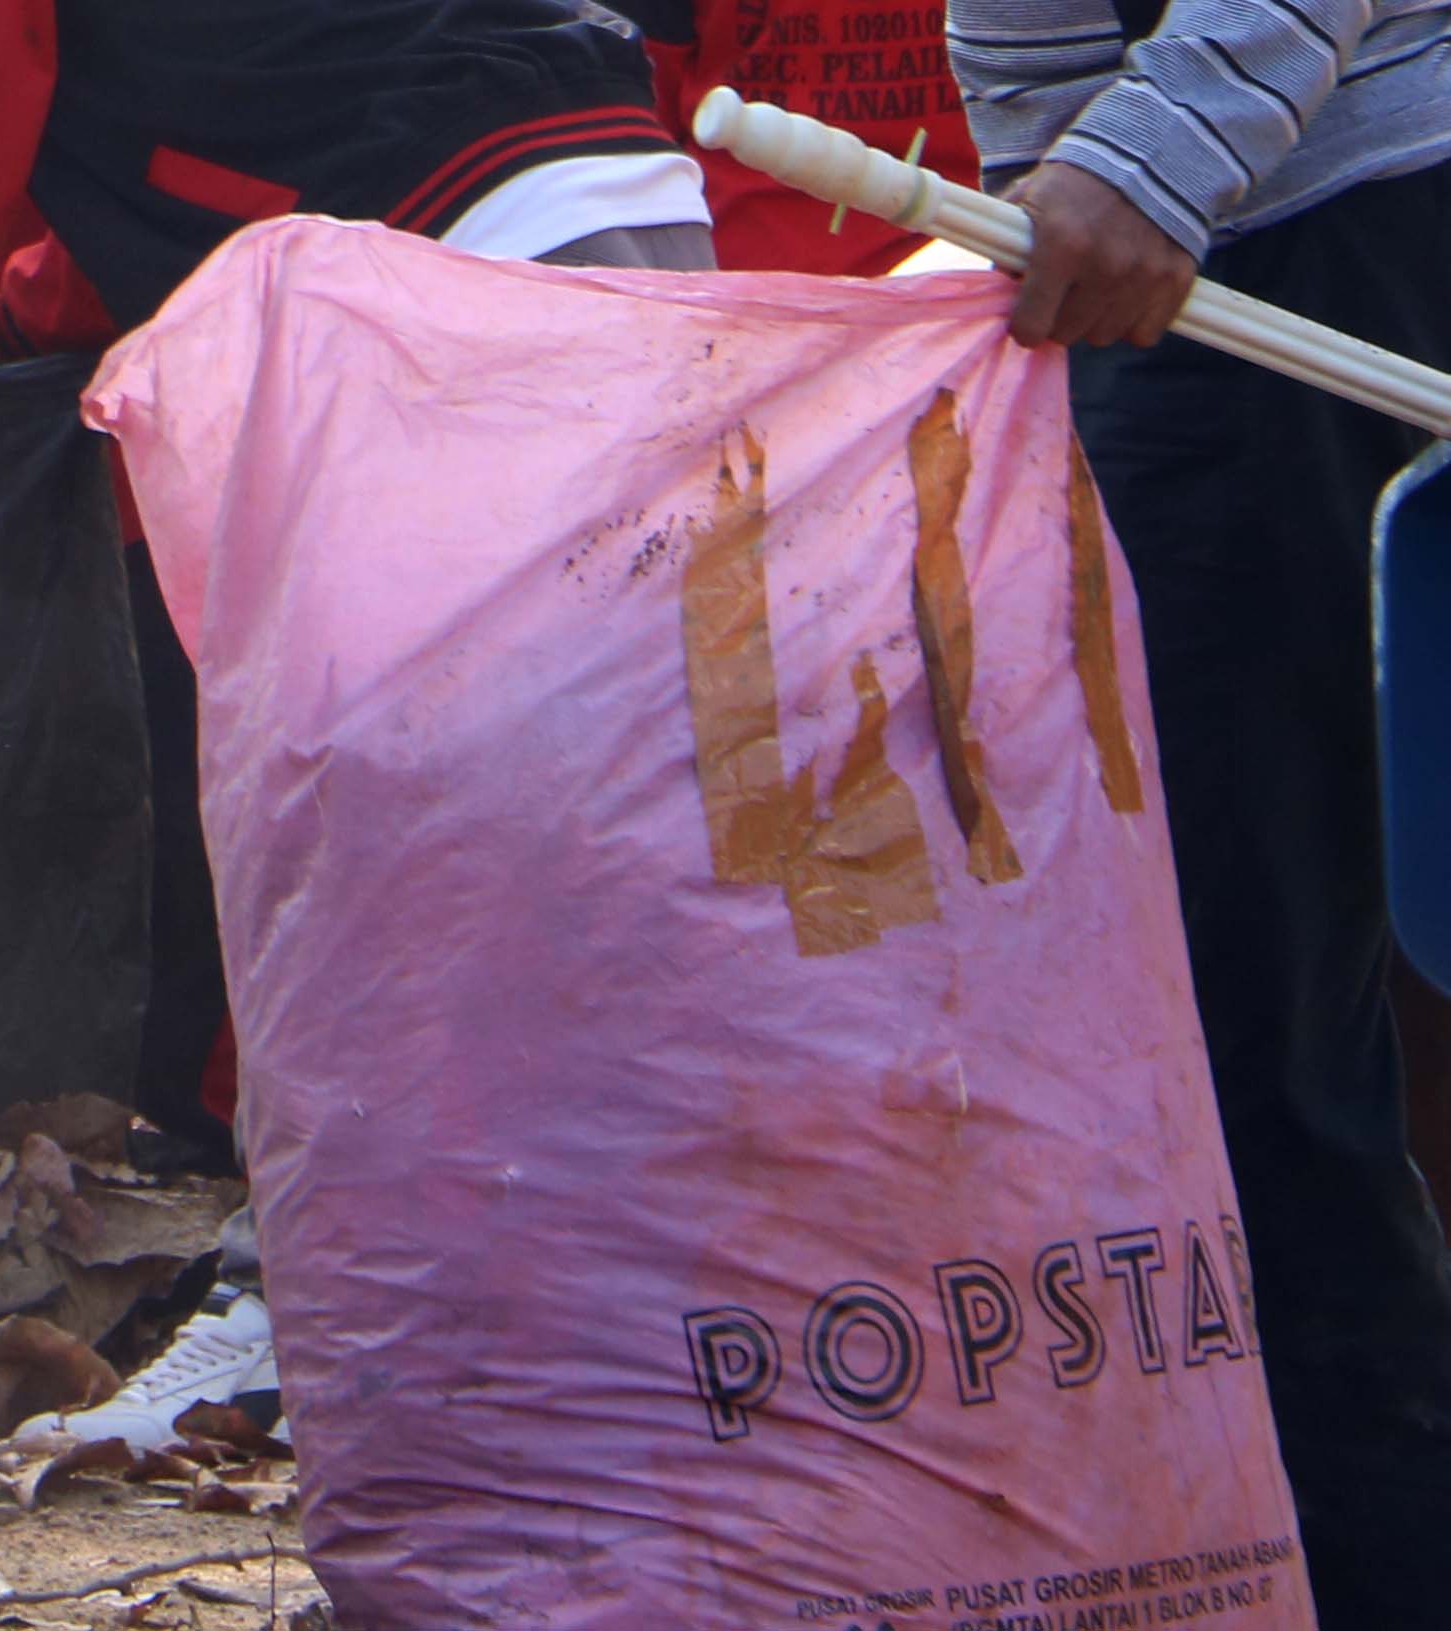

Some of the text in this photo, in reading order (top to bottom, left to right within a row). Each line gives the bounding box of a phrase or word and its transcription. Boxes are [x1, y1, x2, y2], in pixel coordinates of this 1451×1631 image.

[840, 6, 945, 45] 102010
[810, 82, 929, 121] TANAH
[945, 1579, 1027, 1612] PUSAT
[1033, 1568, 1124, 1604] GROSIR
[1128, 1555, 1195, 1590] METRO
[1195, 1544, 1253, 1575] TANAH
[1057, 1599, 1138, 1631] LANTAI
[1158, 1589, 1210, 1623] BLOK
[1211, 1586, 1226, 1612] B
